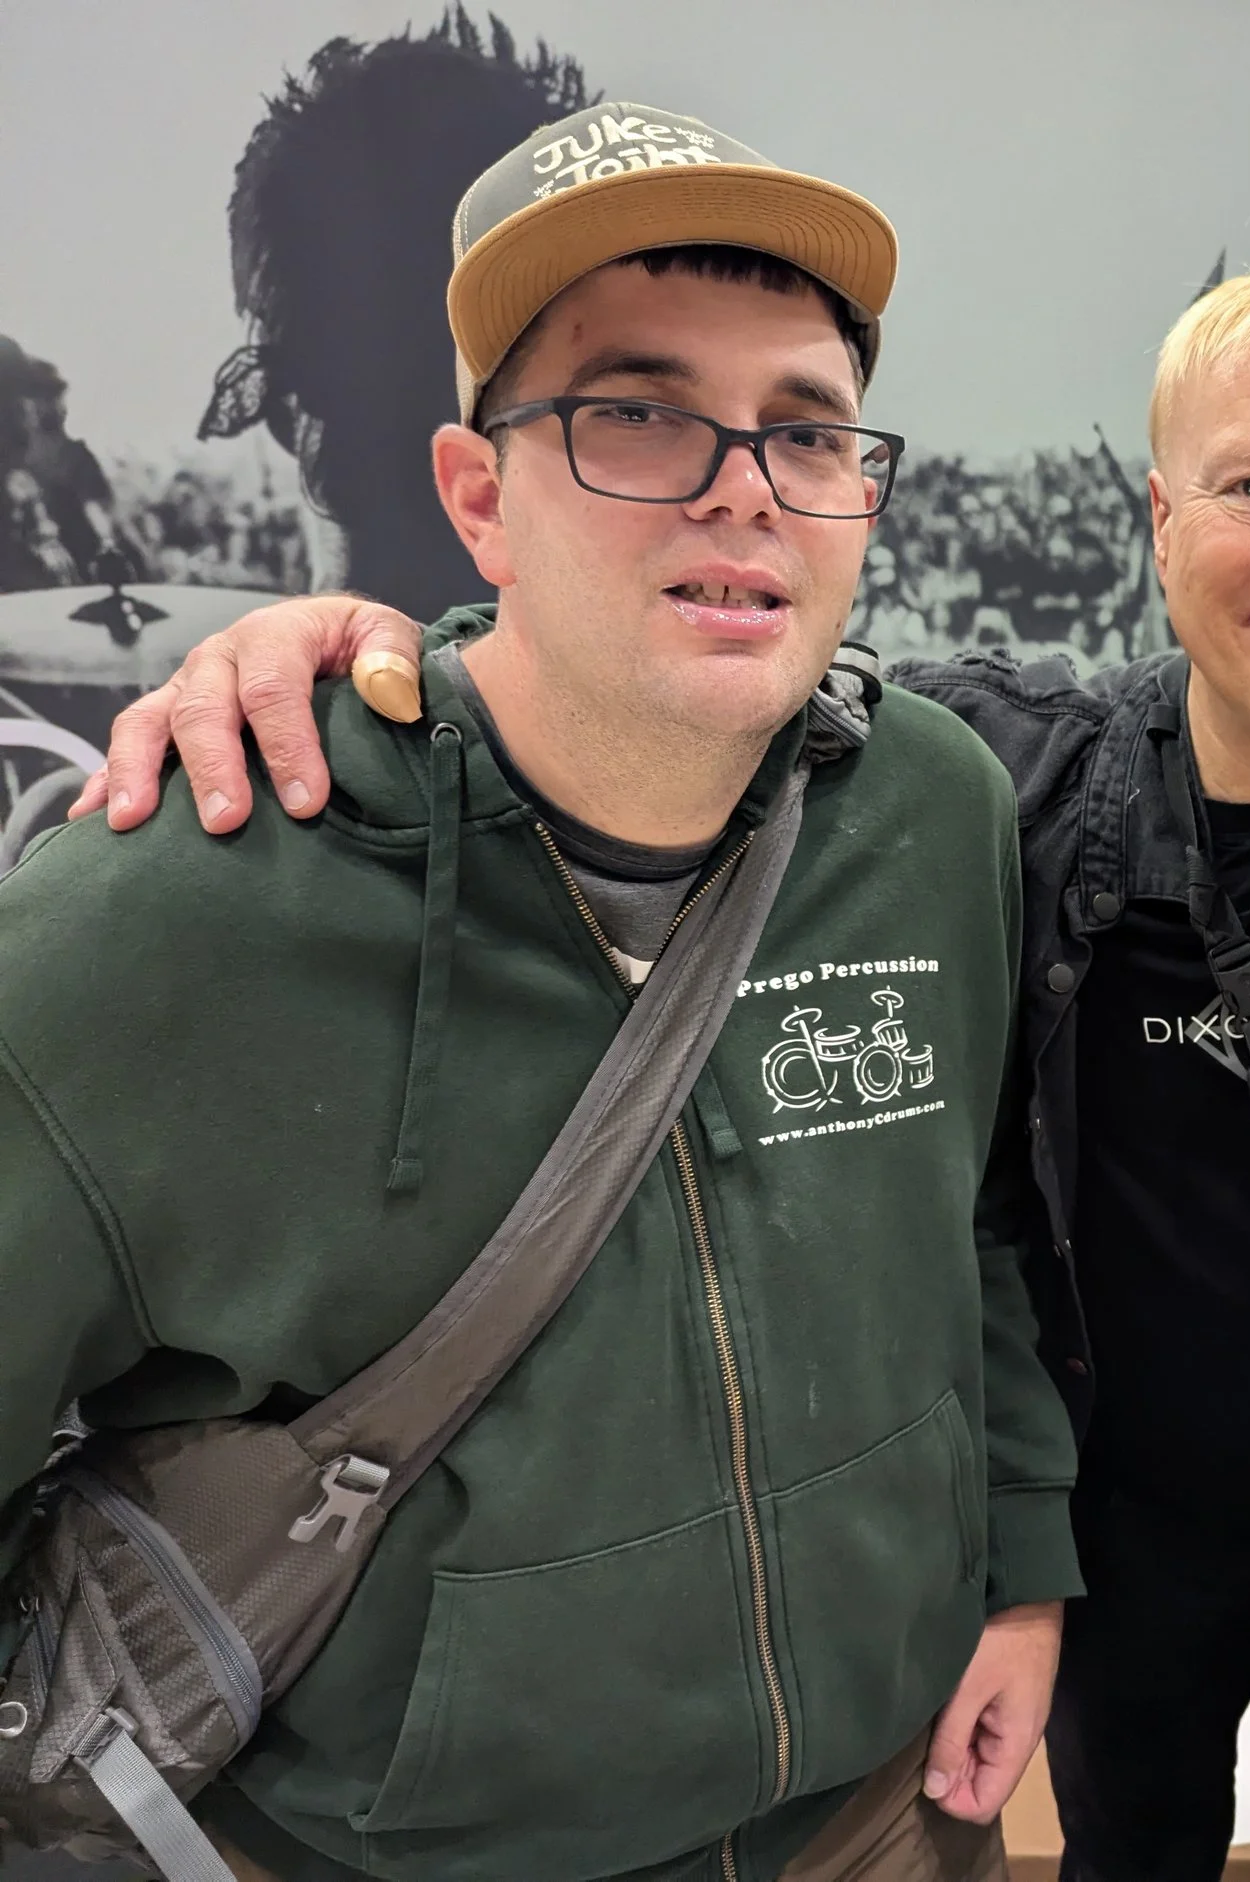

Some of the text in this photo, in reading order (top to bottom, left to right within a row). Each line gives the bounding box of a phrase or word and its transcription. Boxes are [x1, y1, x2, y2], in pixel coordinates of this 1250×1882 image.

[735, 956, 940, 998] Prego Percussion
[757, 1099, 946, 1146] www.anthonyCdrums.com
